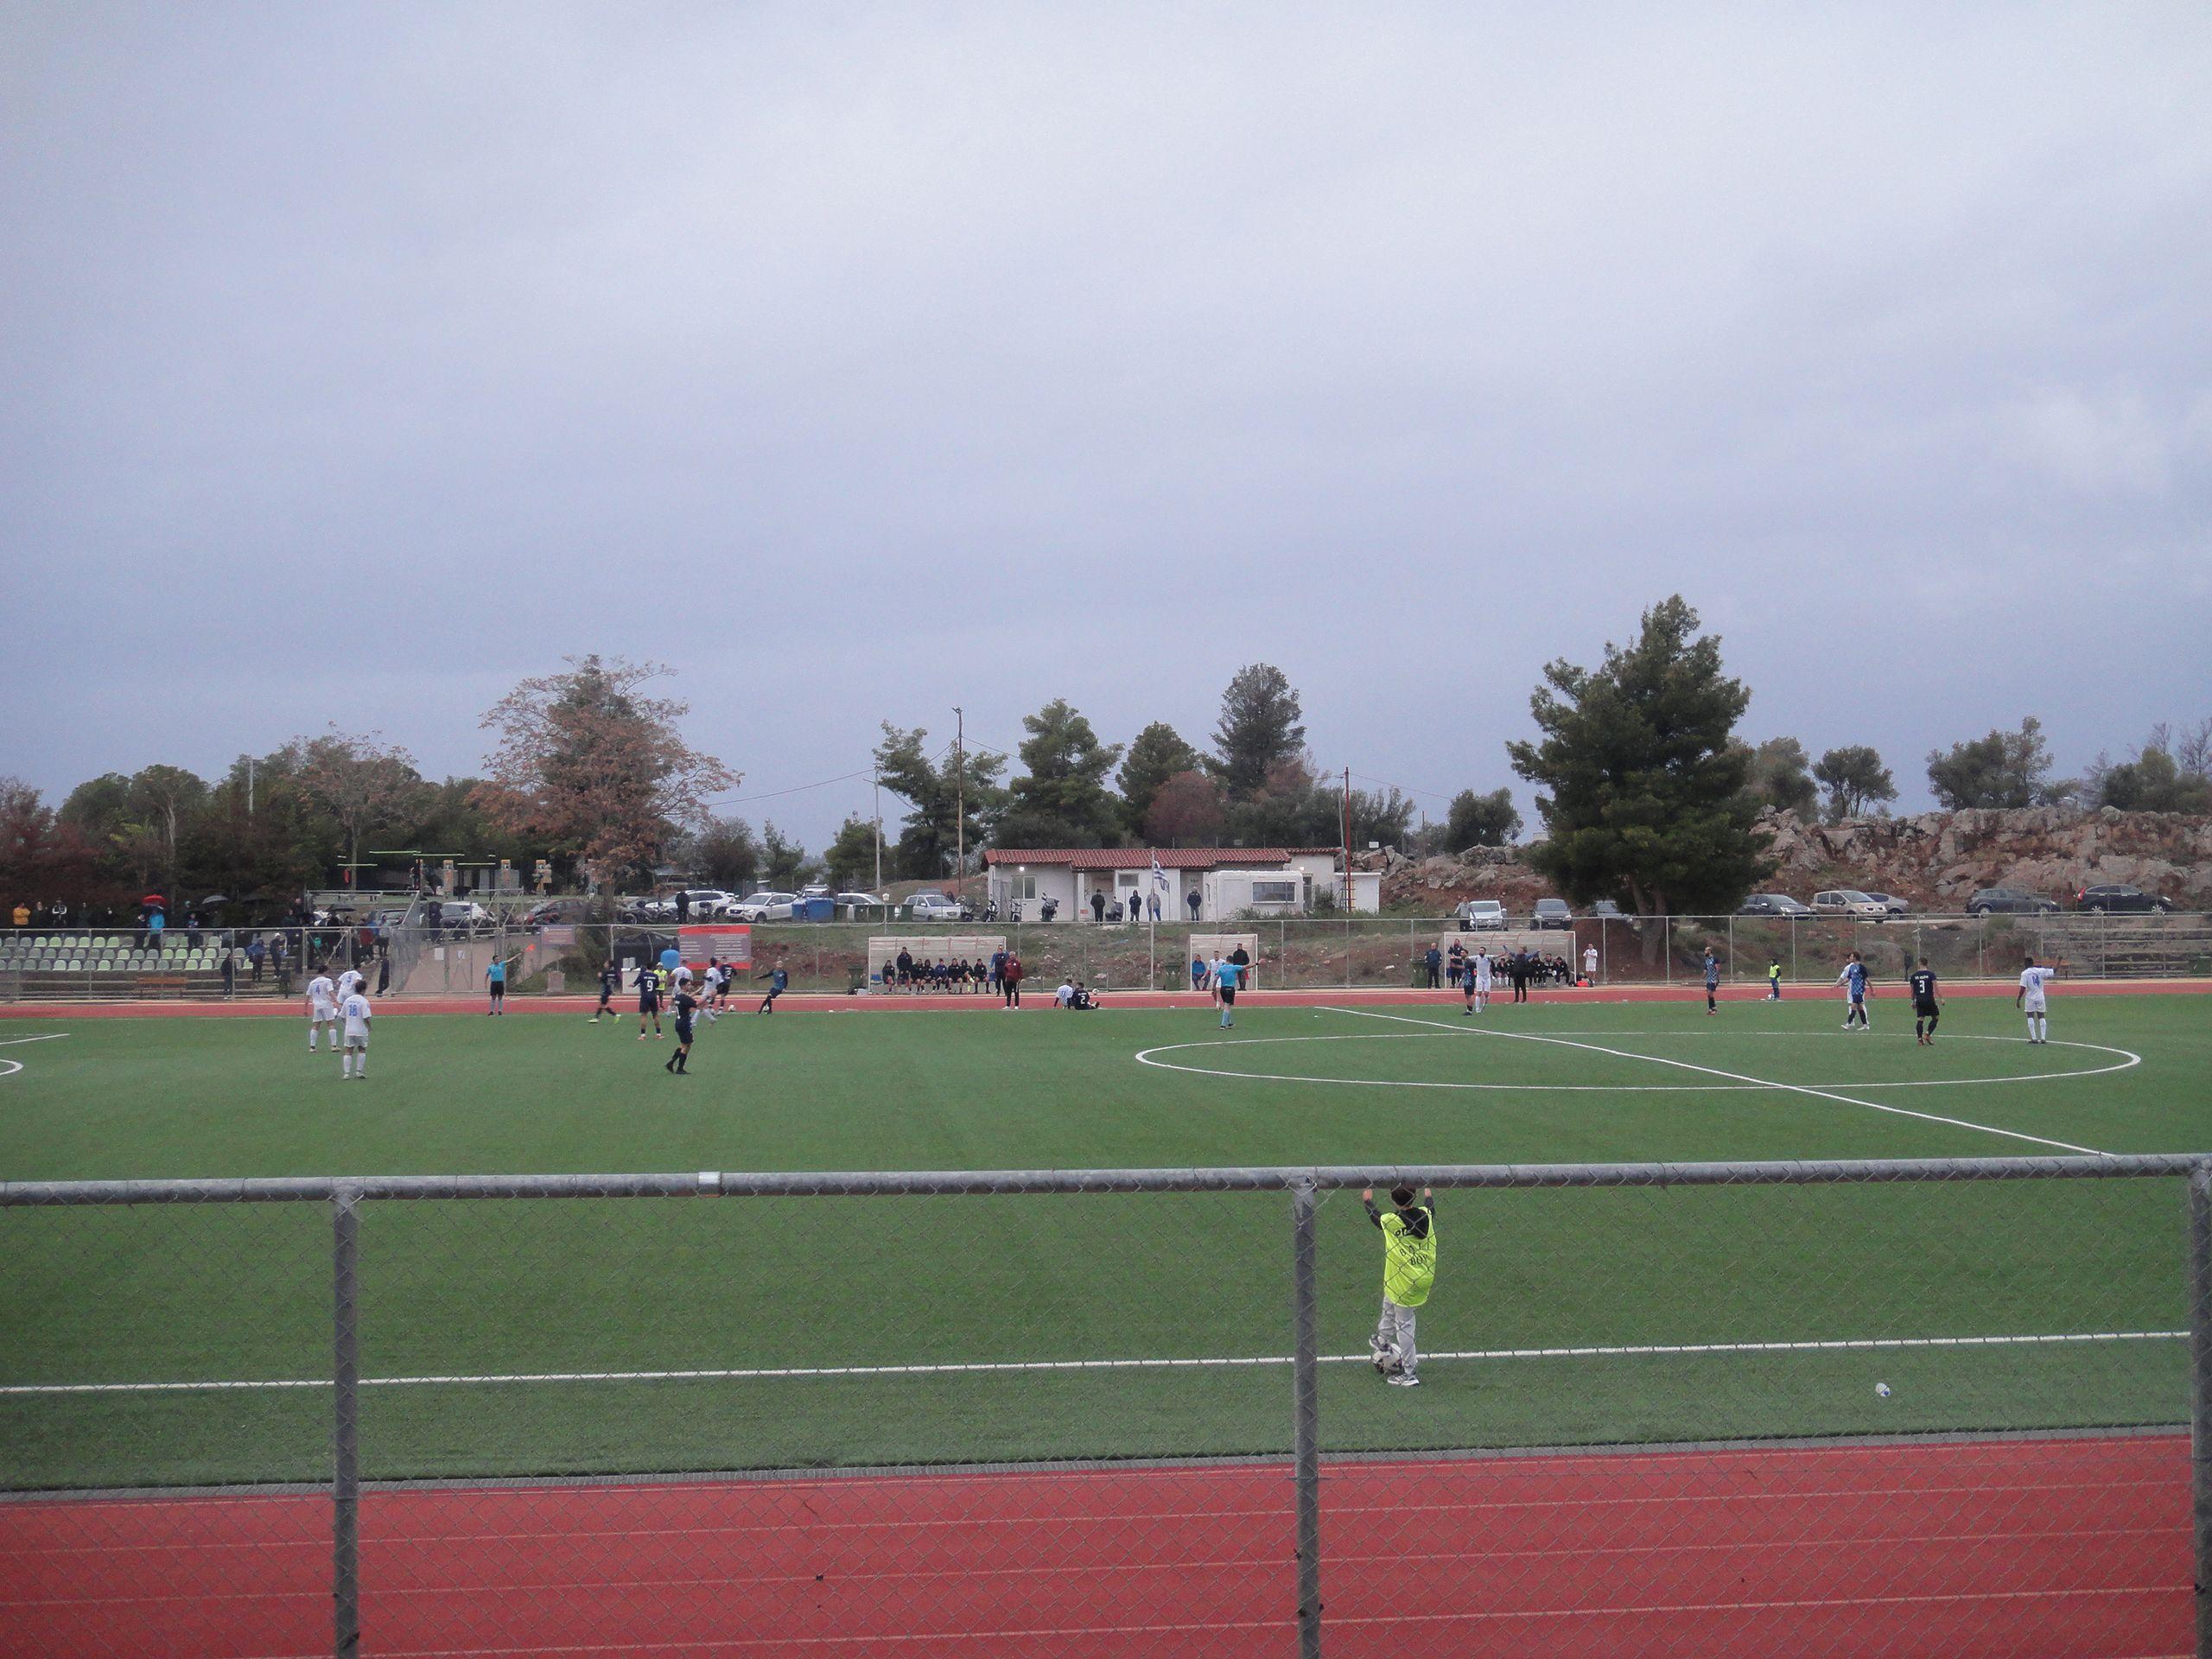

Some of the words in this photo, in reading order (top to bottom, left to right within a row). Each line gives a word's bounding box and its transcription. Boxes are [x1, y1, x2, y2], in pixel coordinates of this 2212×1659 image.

[315, 985, 321, 995] 4
[647, 980, 653, 992] 9
[1919, 980, 1925, 994] 3
[1080, 995, 1086, 1005] 2
